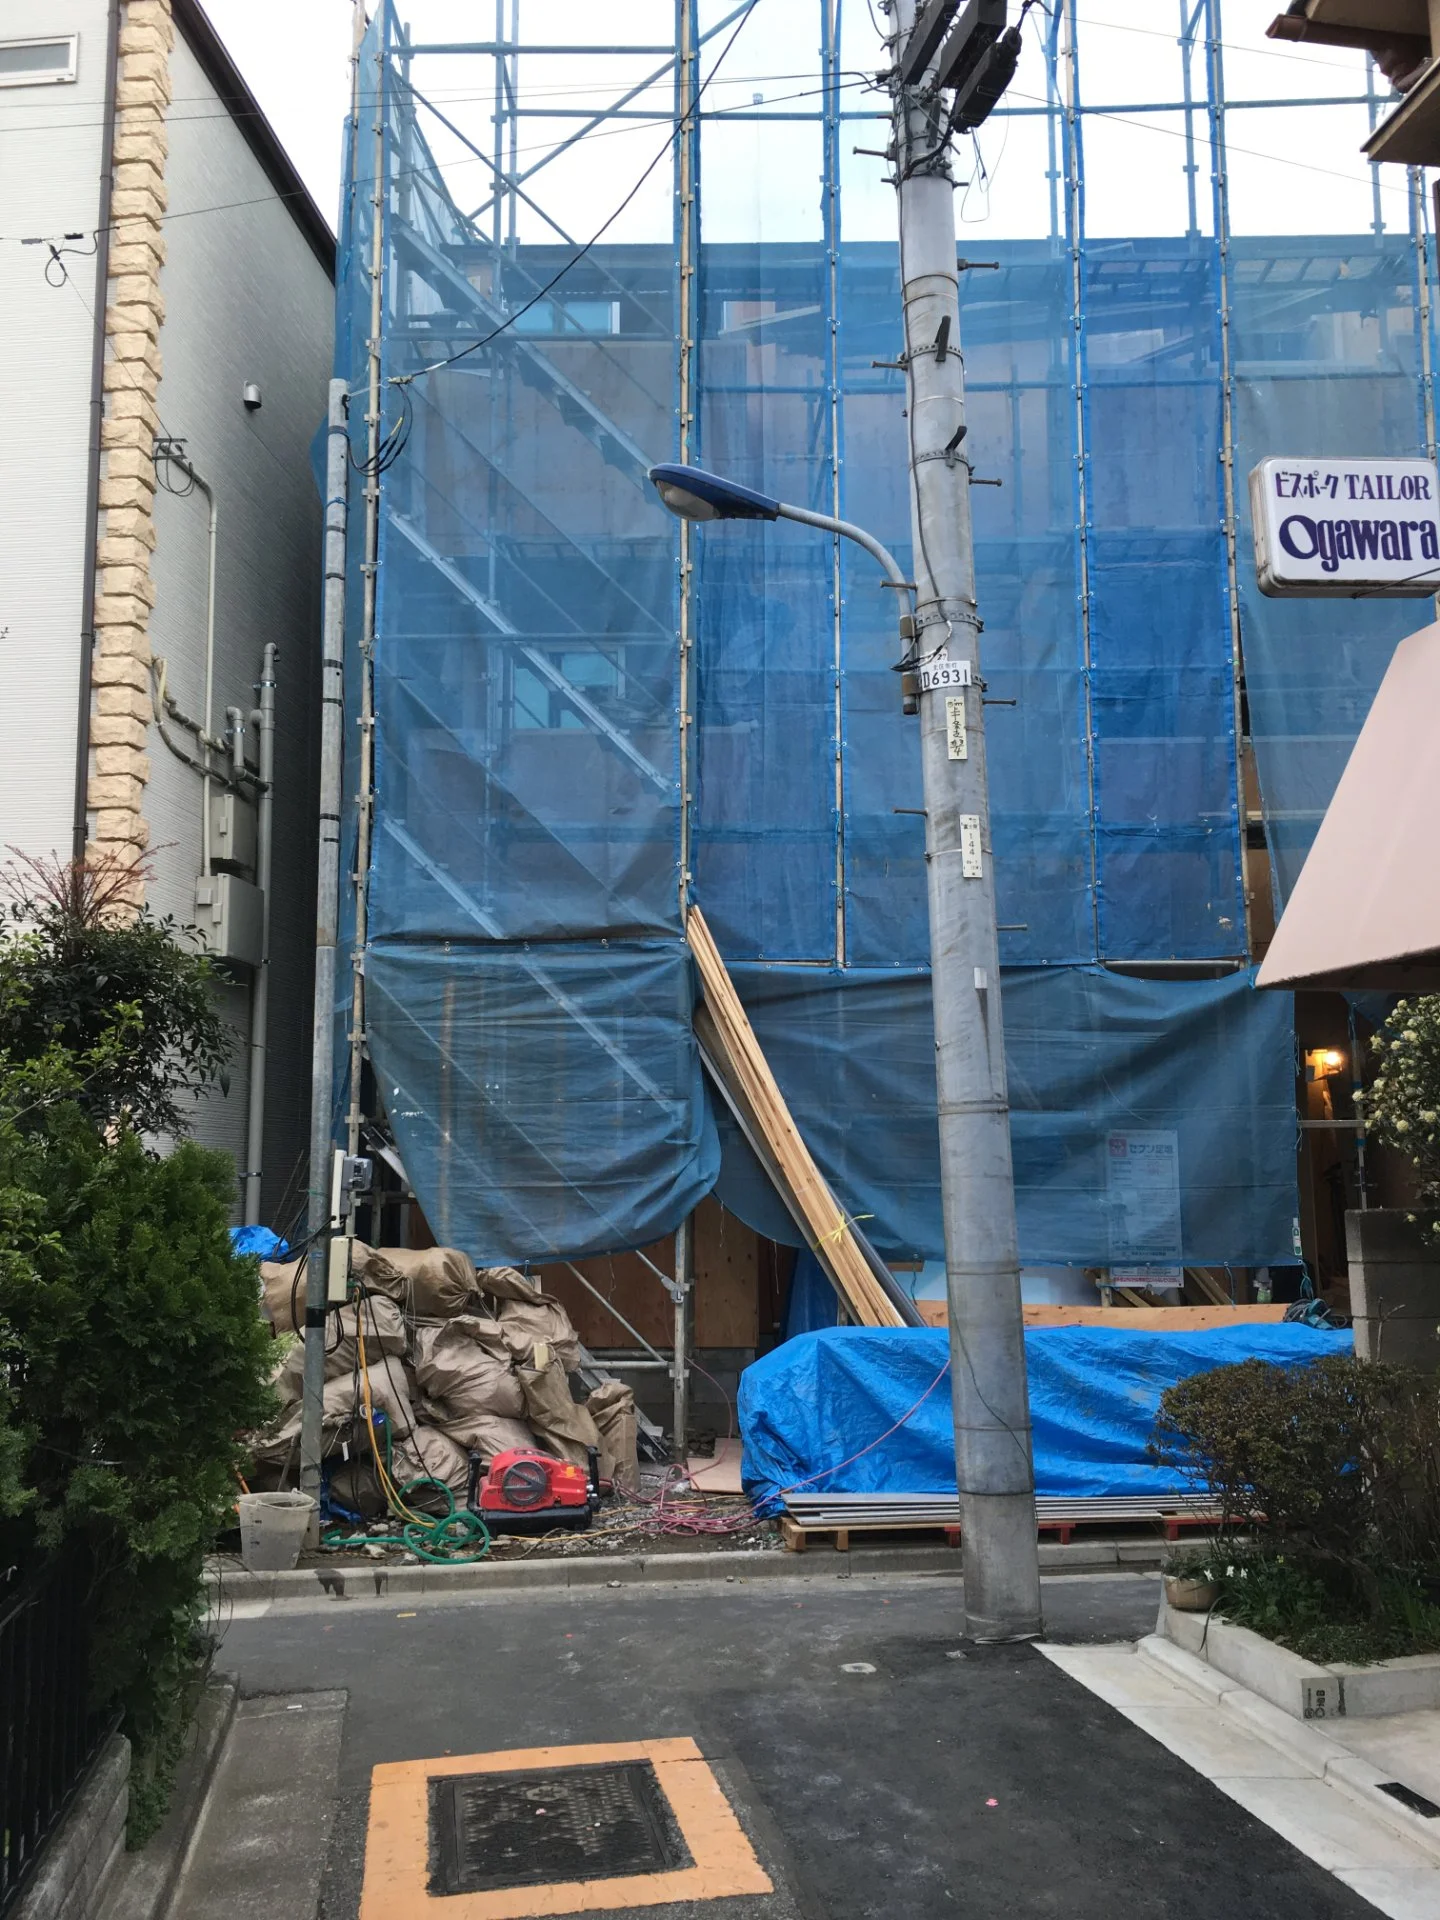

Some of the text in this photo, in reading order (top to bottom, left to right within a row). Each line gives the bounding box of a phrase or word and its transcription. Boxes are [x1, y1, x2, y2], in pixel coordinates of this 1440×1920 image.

[1275, 470, 1432, 500] ビスポーク TAILOR
[1279, 514, 1440, 573] Ogawara
[922, 668, 968, 689] D6931
